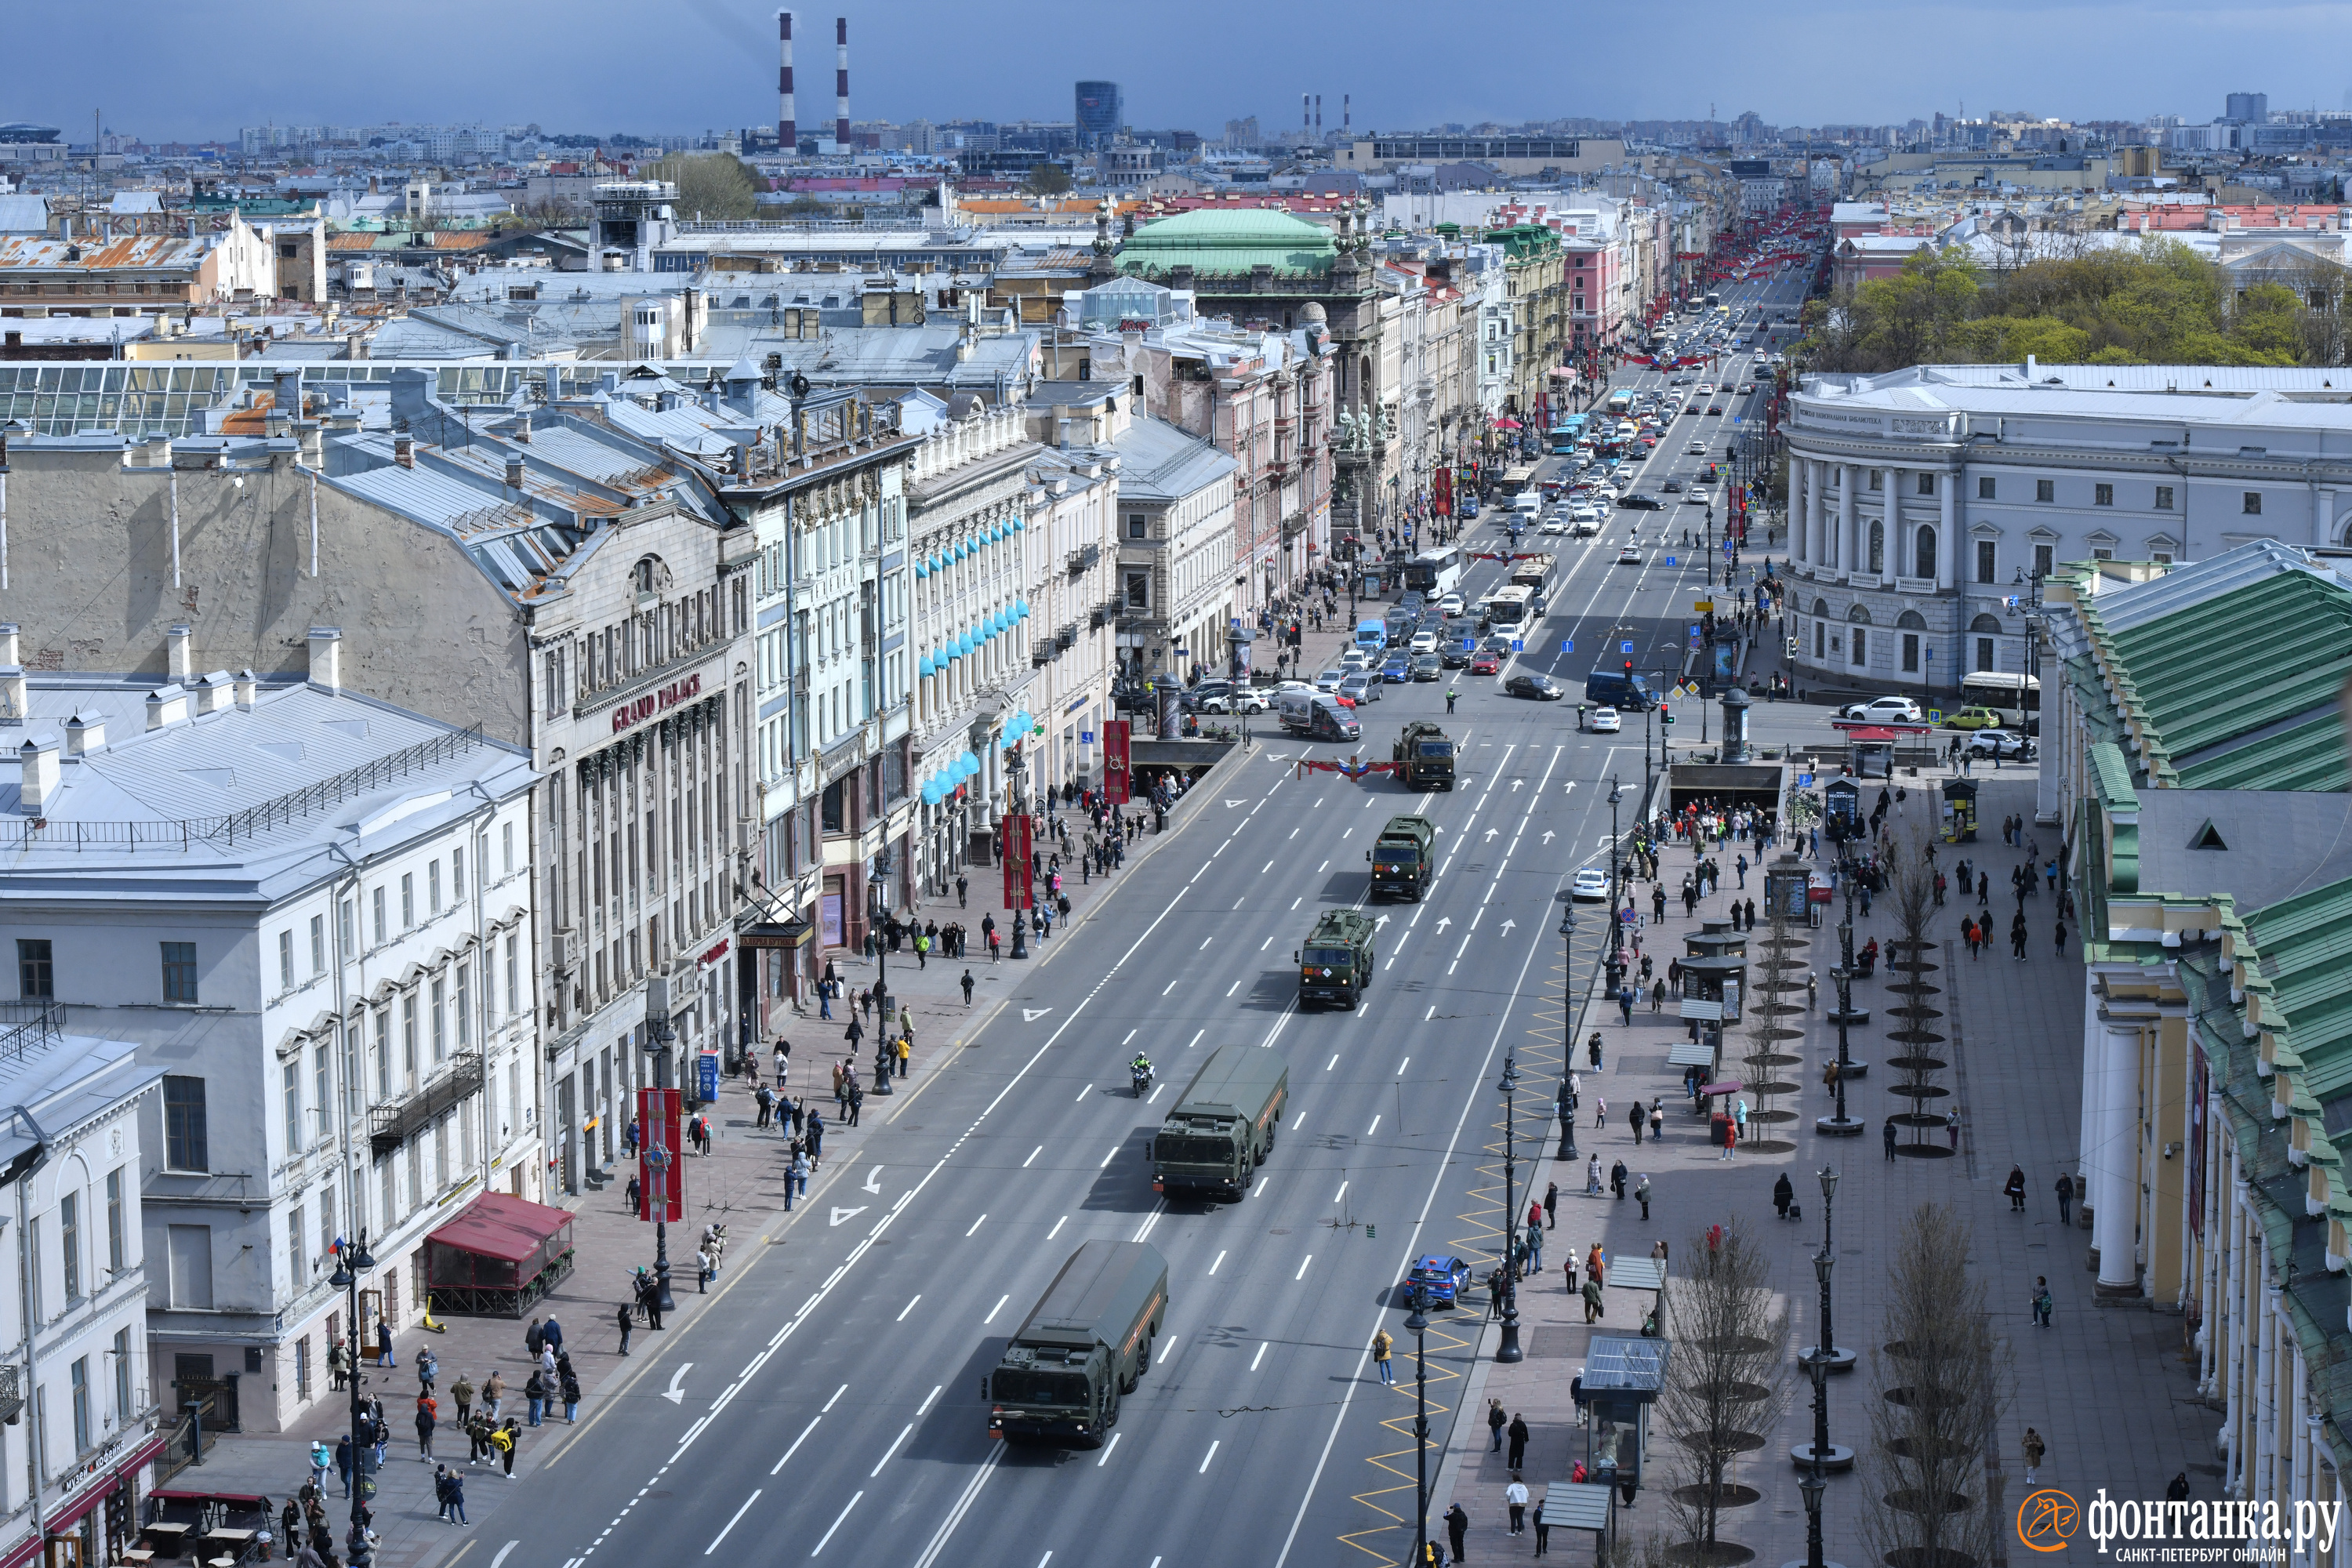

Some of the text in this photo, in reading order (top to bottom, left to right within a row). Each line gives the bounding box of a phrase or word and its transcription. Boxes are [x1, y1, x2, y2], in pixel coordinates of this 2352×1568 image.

[1849, 416, 1882, 425] БИБЛИОТЕКА
[612, 673, 701, 731] GRAND PALACE
[741, 937, 797, 946] ГАЛЕРЕЯ БУТИКОВ
[647, 1109, 666, 1120] 1941
[96, 1440, 125, 1468] кофейня
